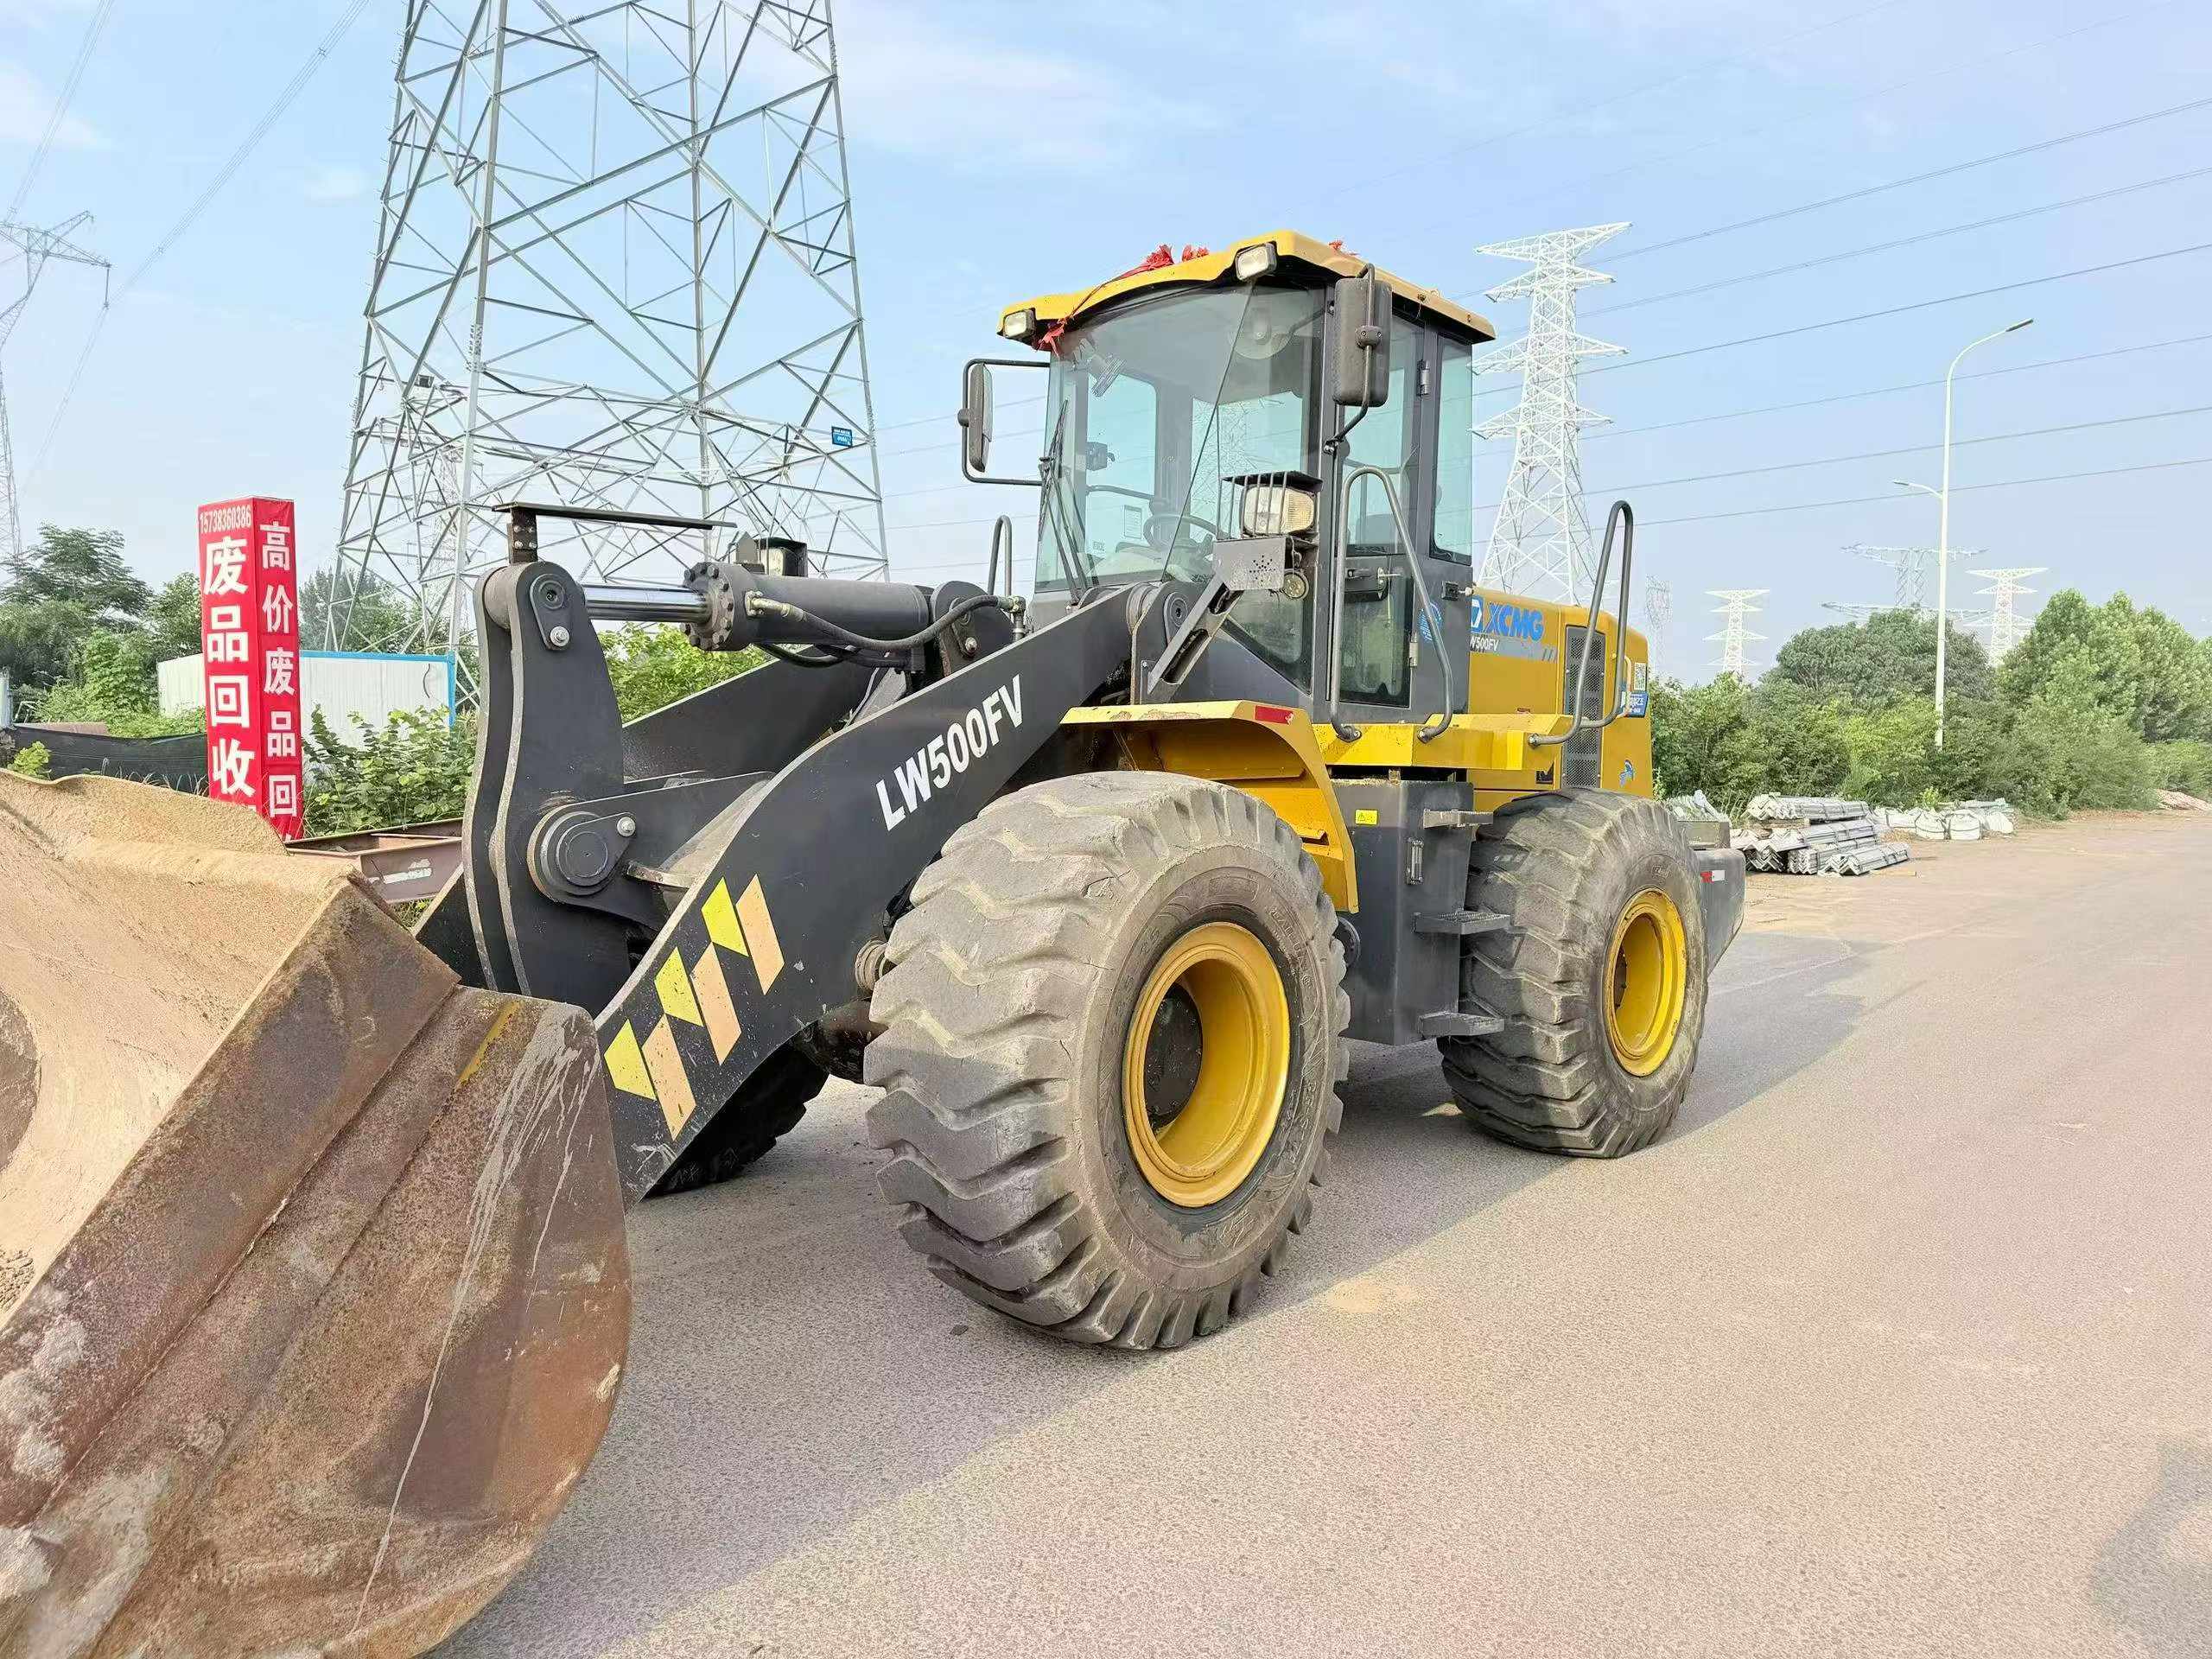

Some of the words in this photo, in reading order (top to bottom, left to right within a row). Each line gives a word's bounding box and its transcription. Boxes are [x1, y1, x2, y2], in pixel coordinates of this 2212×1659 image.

[203, 536, 257, 810] 废品回收
[260, 521, 297, 841] 高价废品回
[1470, 635, 1499, 652] W500FV
[1486, 603, 1544, 643] XCMG
[875, 674, 1023, 831] LW500FV
